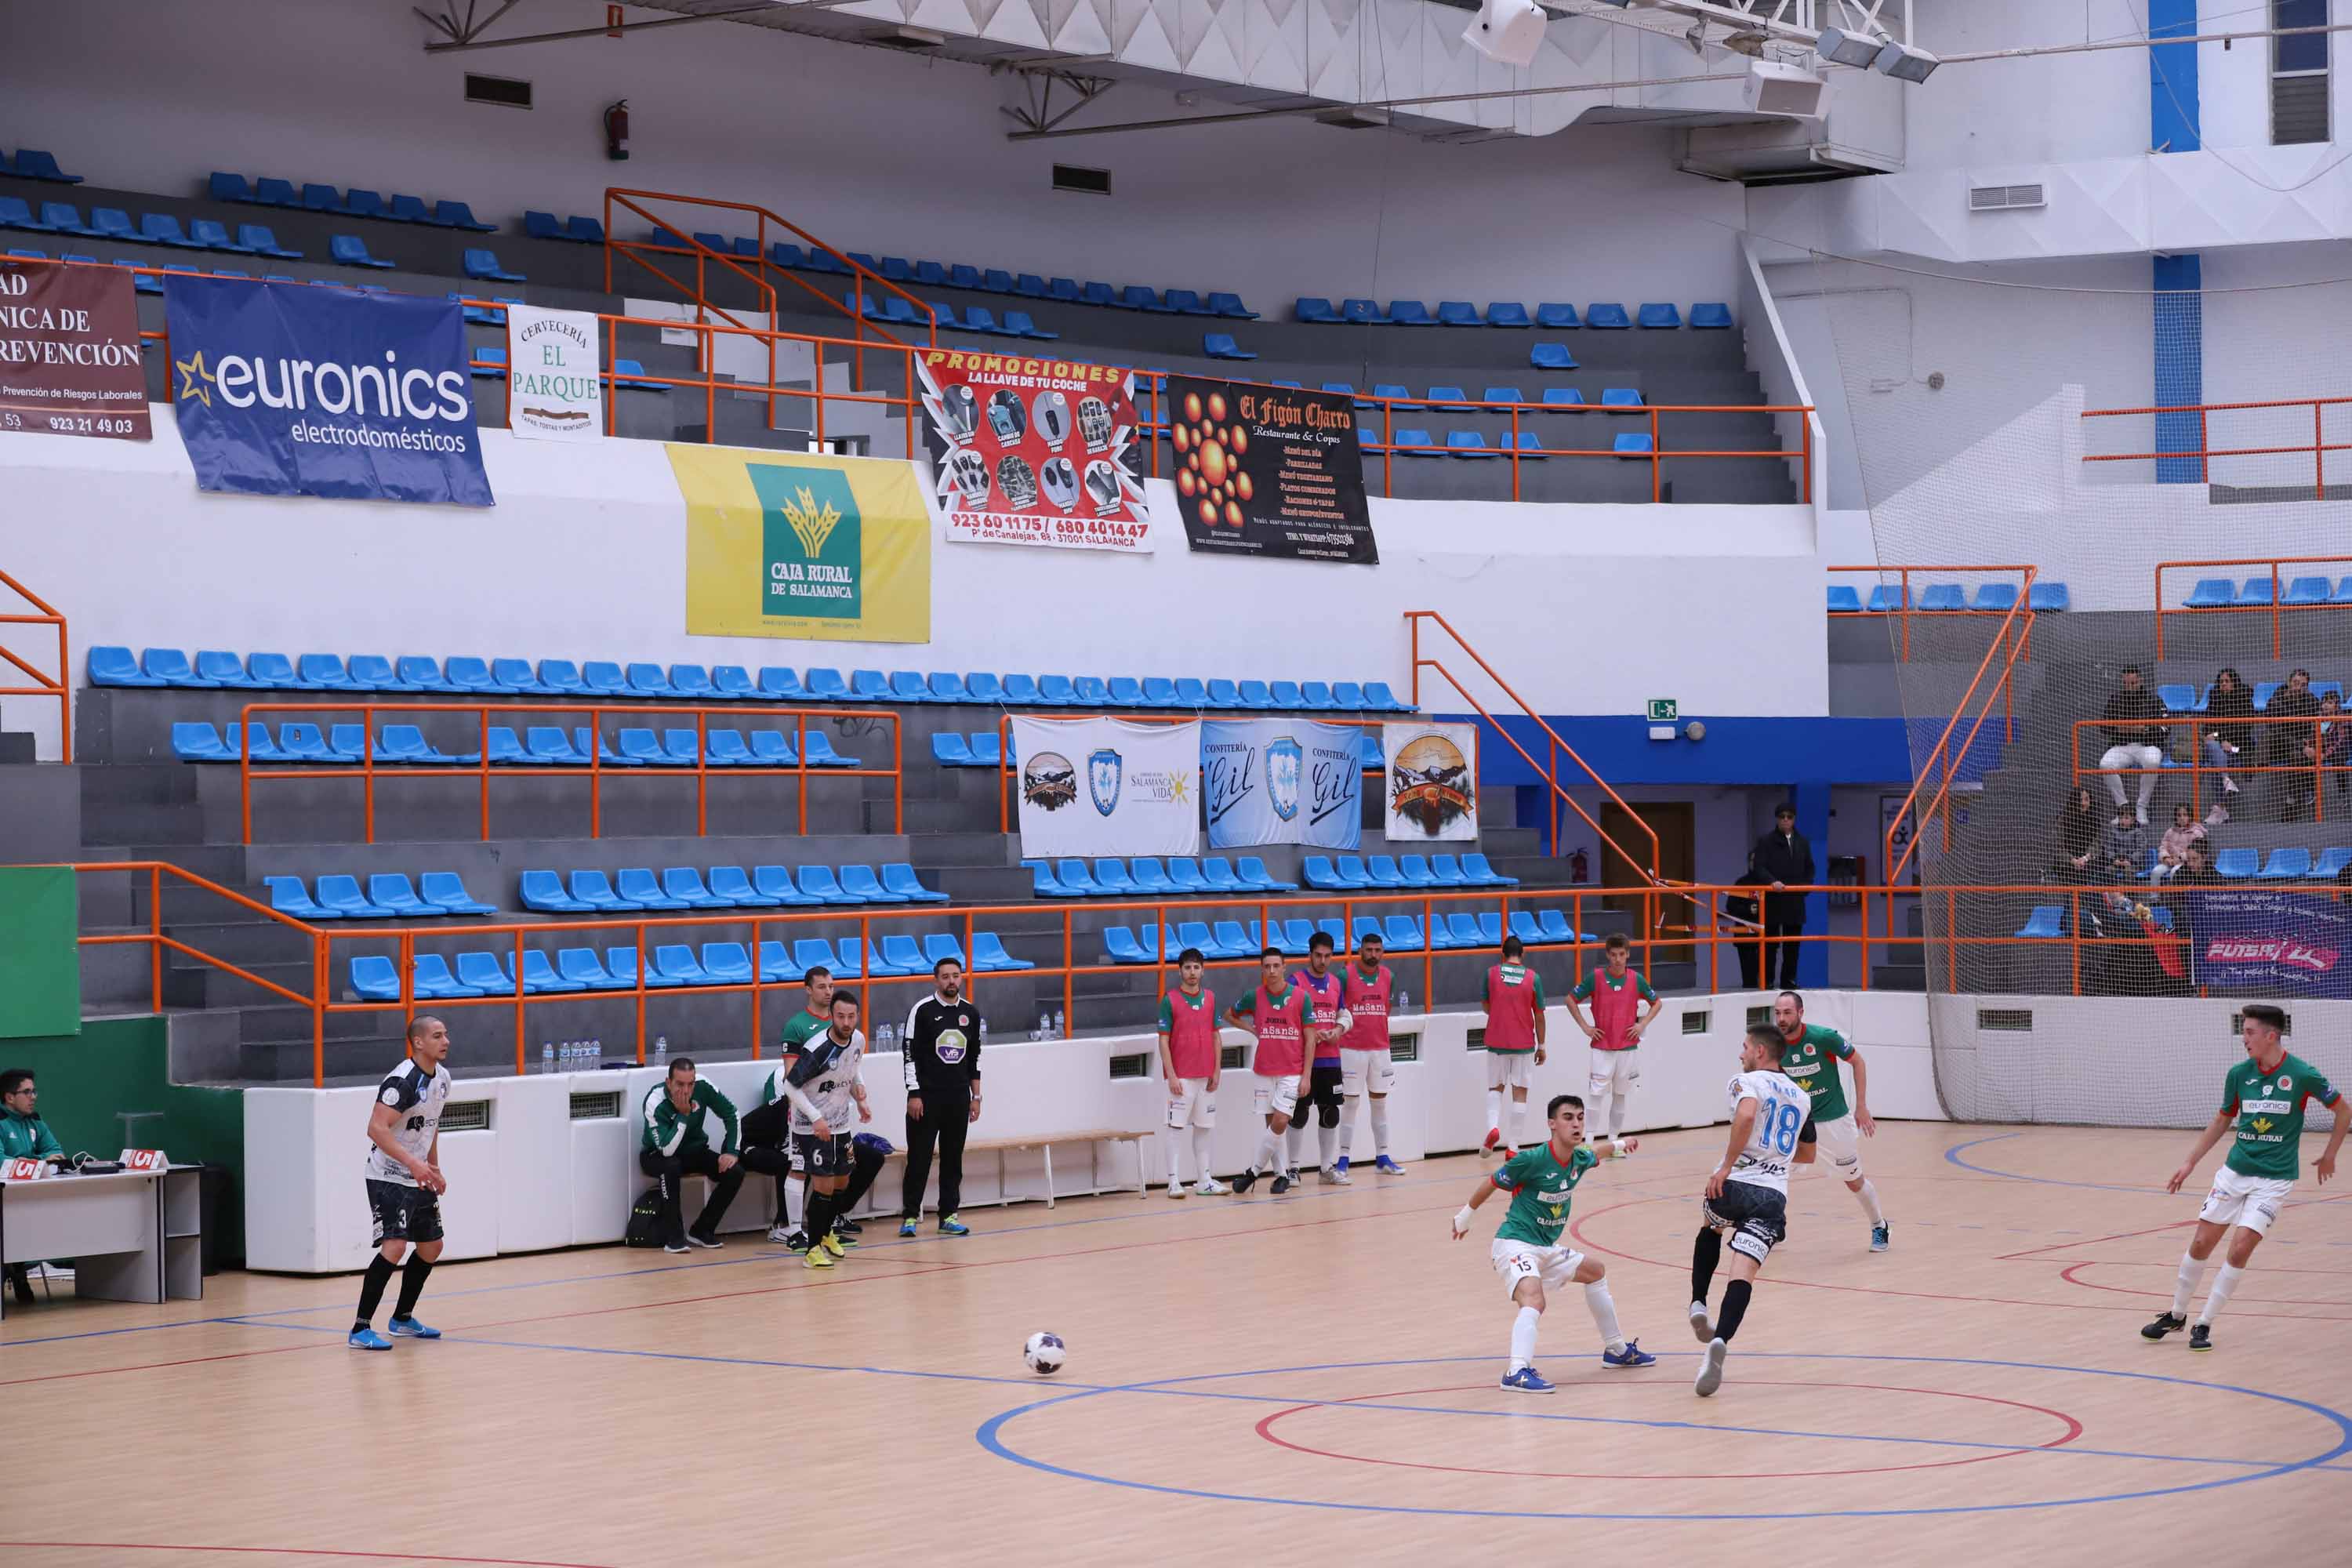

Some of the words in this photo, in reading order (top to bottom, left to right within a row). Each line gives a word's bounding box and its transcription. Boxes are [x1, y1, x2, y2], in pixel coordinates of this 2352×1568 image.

[60, 308, 90, 332] DE
[521, 320, 586, 349] CERVECERÍA
[543, 344, 566, 367] EL
[926, 351, 1120, 383] PROMOCIONES
[216, 350, 468, 422] euronics
[513, 372, 598, 402] PARQUE
[967, 372, 982, 383] LA
[983, 372, 1018, 387] LLAVE
[1020, 376, 1035, 387] DE
[1036, 377, 1051, 389] TU
[1051, 378, 1087, 392] COCHE
[2, 386, 49, 398] Prevención
[50, 389, 62, 398] de
[64, 389, 97, 401] Riesgos
[99, 390, 143, 401] Laborales
[1240, 394, 1257, 420] El
[1260, 397, 1301, 428] Figón
[1305, 401, 1351, 431] Charro
[49, 417, 74, 430] 923
[77, 419, 93, 432] 21
[96, 419, 112, 432] 49
[115, 419, 132, 434] 03
[1252, 425, 1301, 441] Restaurante
[1302, 431, 1314, 441] &
[1316, 432, 1341, 445] Copas
[292, 419, 466, 453] electrodomésticos
[951, 514, 981, 528] 923
[983, 514, 1003, 528] 60
[1055, 520, 1085, 534] 680
[982, 528, 995, 538] de
[1085, 535, 1135, 547] SALAMANCA
[771, 562, 804, 581] CAJA
[807, 564, 852, 583] RURAL
[771, 583, 786, 595] DE
[789, 584, 852, 599] SALAMANCA
[1204, 741, 1248, 753] CONFITERÍA
[1312, 747, 1350, 760] CONFITERÍA
[1152, 786, 1174, 798] VIDA
[1759, 1097, 1801, 1156] 18
[134, 1150, 153, 1167] 5
[812, 1149, 823, 1166] 6
[15, 1160, 33, 1176] 5
[398, 1209, 407, 1229] 3
[1735, 1237, 1767, 1255] euronic
[1517, 1261, 1532, 1272] 15
